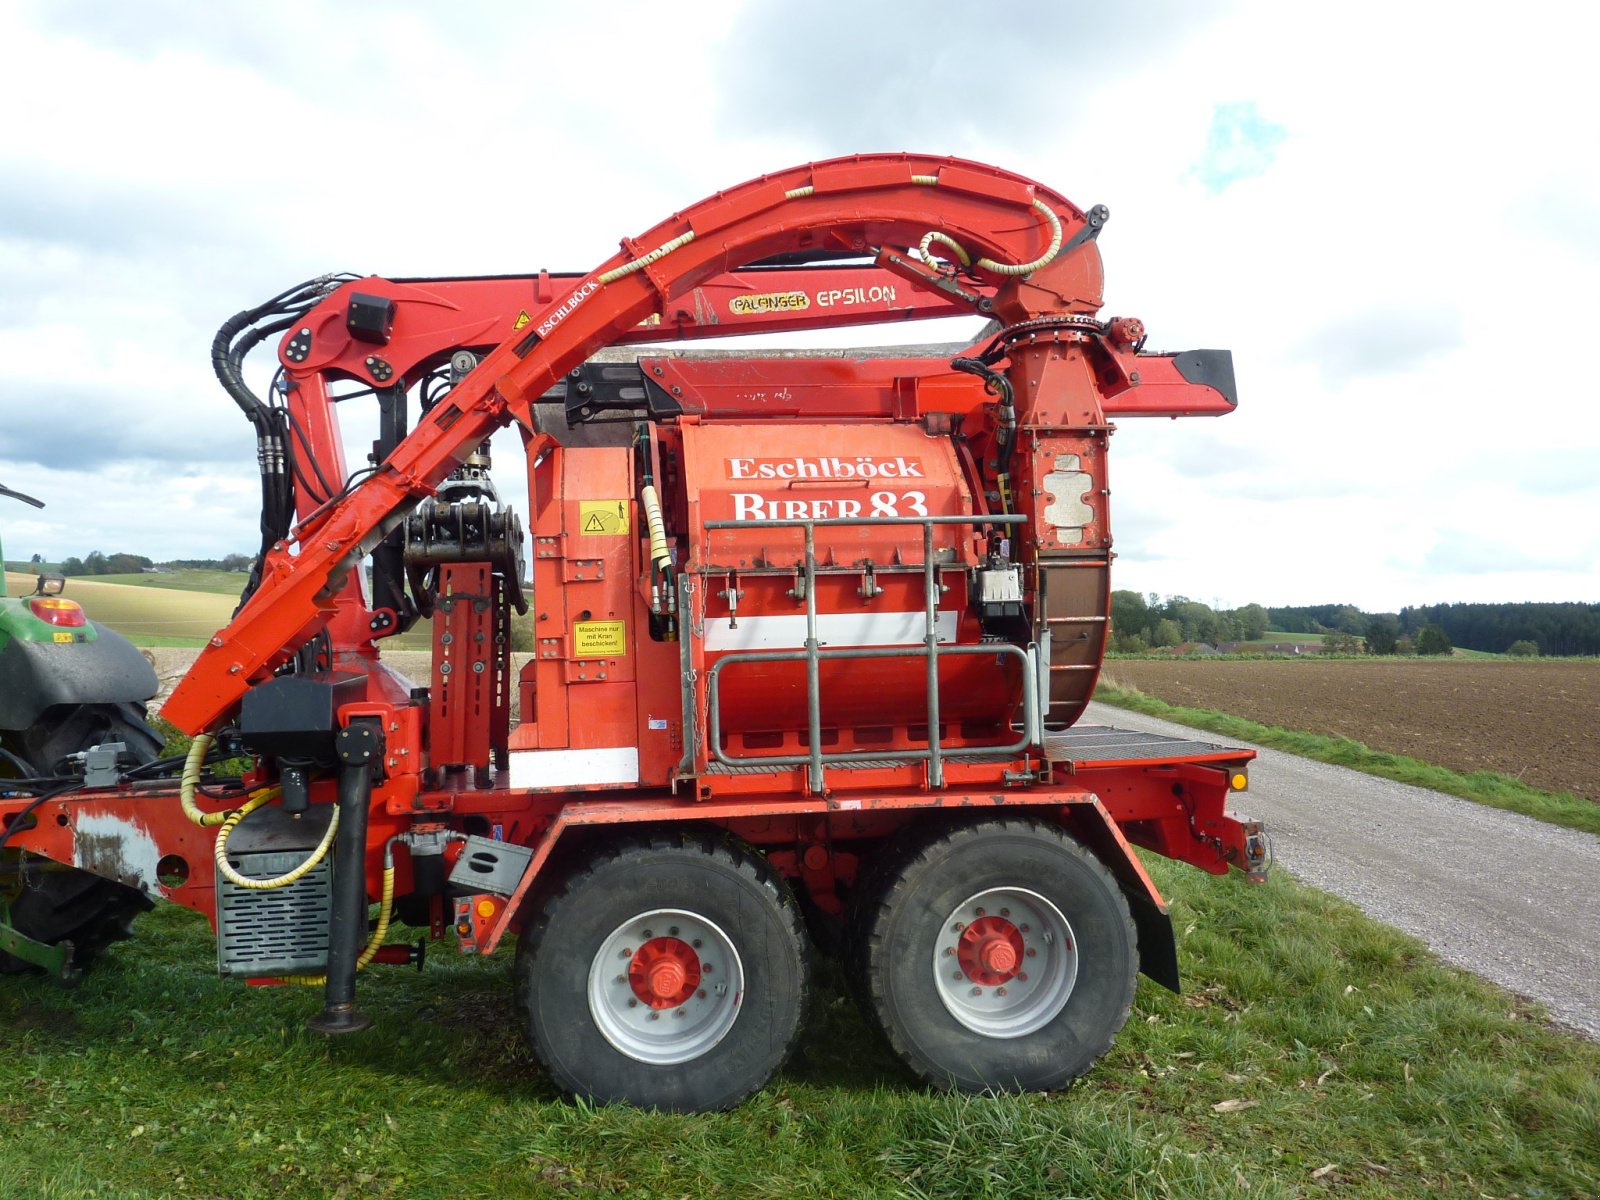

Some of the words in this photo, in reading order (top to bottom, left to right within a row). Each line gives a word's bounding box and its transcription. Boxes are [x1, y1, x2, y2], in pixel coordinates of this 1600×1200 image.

[816, 285, 897, 306] EPSILON
[537, 280, 599, 337] ESCHLBÖCK
[727, 457, 925, 479] Eschlböck
[869, 490, 929, 518] 83
